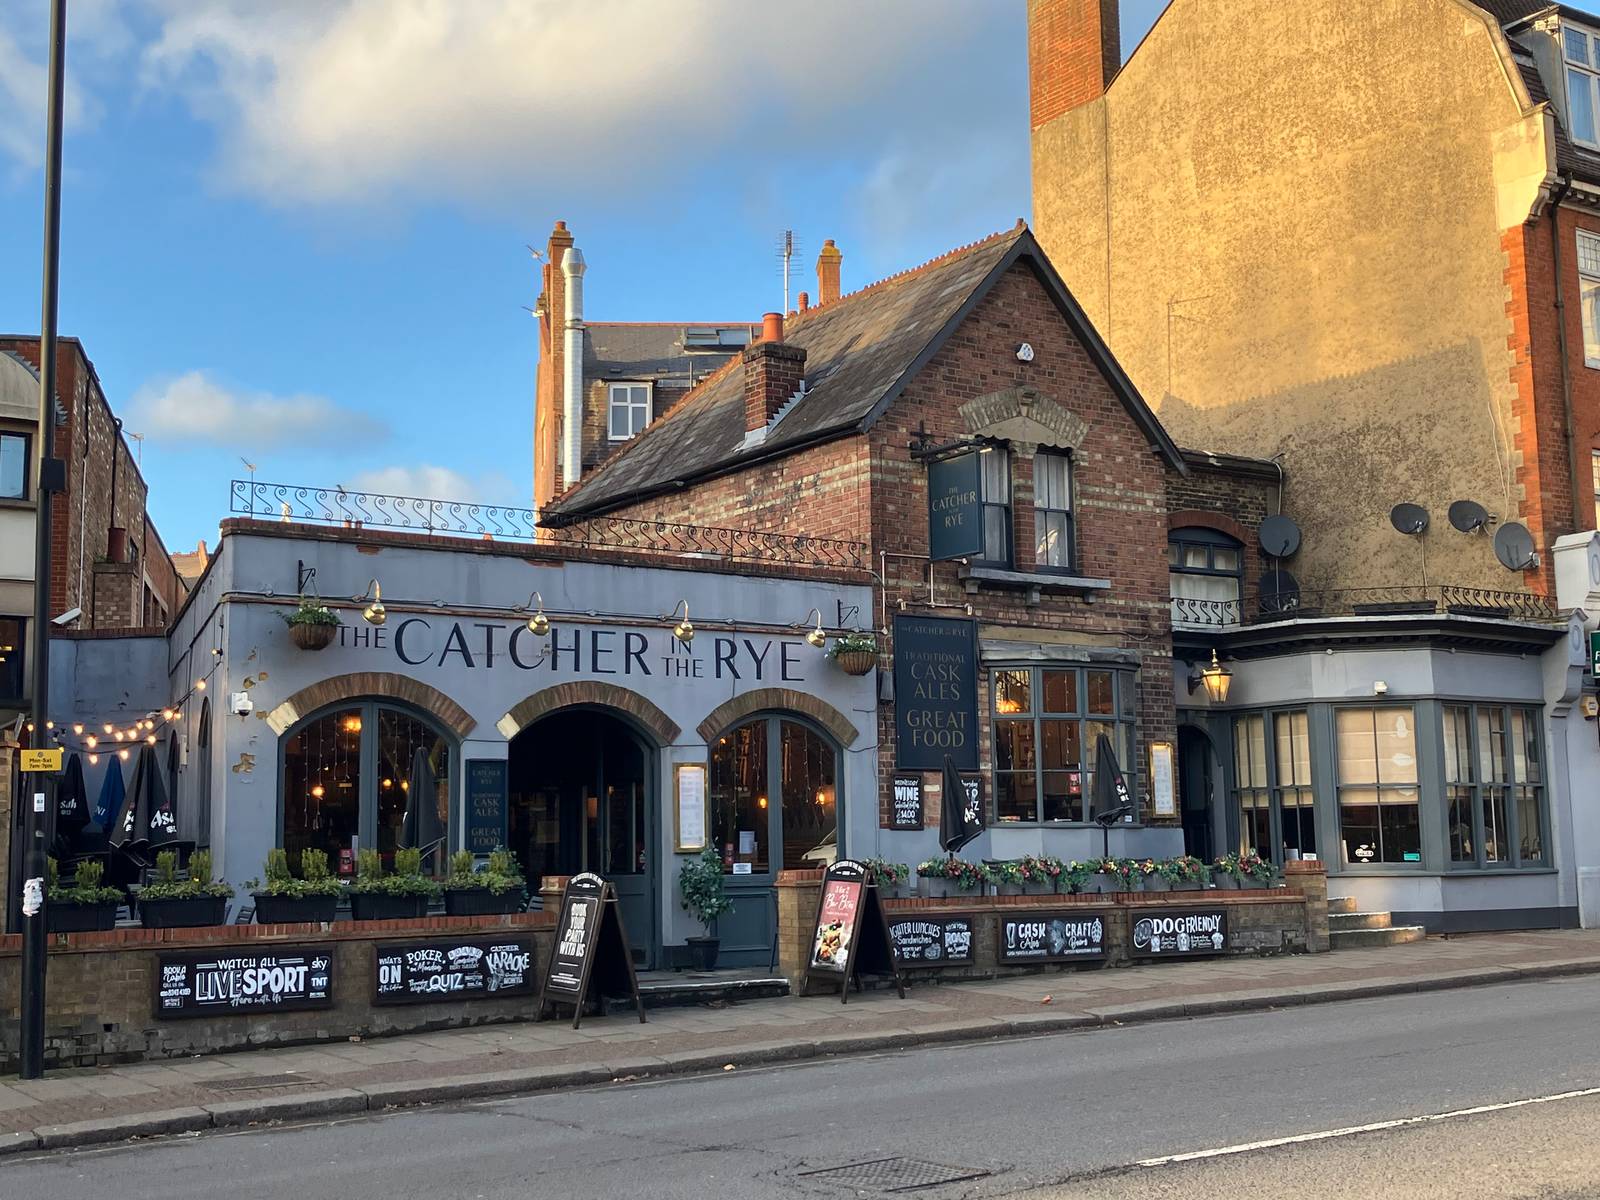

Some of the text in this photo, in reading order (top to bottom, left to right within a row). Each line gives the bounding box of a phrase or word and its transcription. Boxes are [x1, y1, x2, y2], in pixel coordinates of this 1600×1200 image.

[931, 489, 976, 513] CATCHER
[945, 512, 963, 529] RYE
[907, 625, 945, 637] CATCHER
[336, 617, 652, 676] THE CATCHER
[671, 634, 804, 682] IN RYE
[904, 650, 965, 664] TRADITIONAL
[661, 656, 704, 679] THE
[911, 661, 961, 682] CASK
[914, 682, 961, 701] ALES
[907, 708, 969, 729] GREAT
[912, 729, 965, 748] FOOD
[894, 786, 919, 801] WINE
[473, 798, 500, 808] CASK
[475, 807, 500, 817] ALES
[471, 826, 502, 837] GREAT
[472, 837, 501, 849] FOOD
[889, 922, 941, 939] IGHTER LUNCHES
[1018, 922, 1092, 939] CASK CRAFT
[1153, 917, 1186, 935] DOG
[1185, 914, 1222, 934] FRIENDLY
[564, 928, 586, 943] PARTY
[897, 934, 932, 945] Sandwiches
[944, 931, 971, 948] ROAST
[1068, 935, 1088, 950] Beers
[406, 949, 443, 964] POKER
[559, 940, 586, 958] WITH US
[217, 957, 278, 971] WATCH ALL
[311, 956, 328, 971] sky
[417, 961, 442, 973] Monday
[485, 951, 530, 974] KARAOKE
[311, 976, 328, 987] TNT
[379, 964, 402, 984] ON
[426, 972, 465, 993] QUIZ
[195, 965, 309, 1001] LIVE SPORT
[231, 994, 254, 1007] Here
[254, 994, 271, 1005] with
